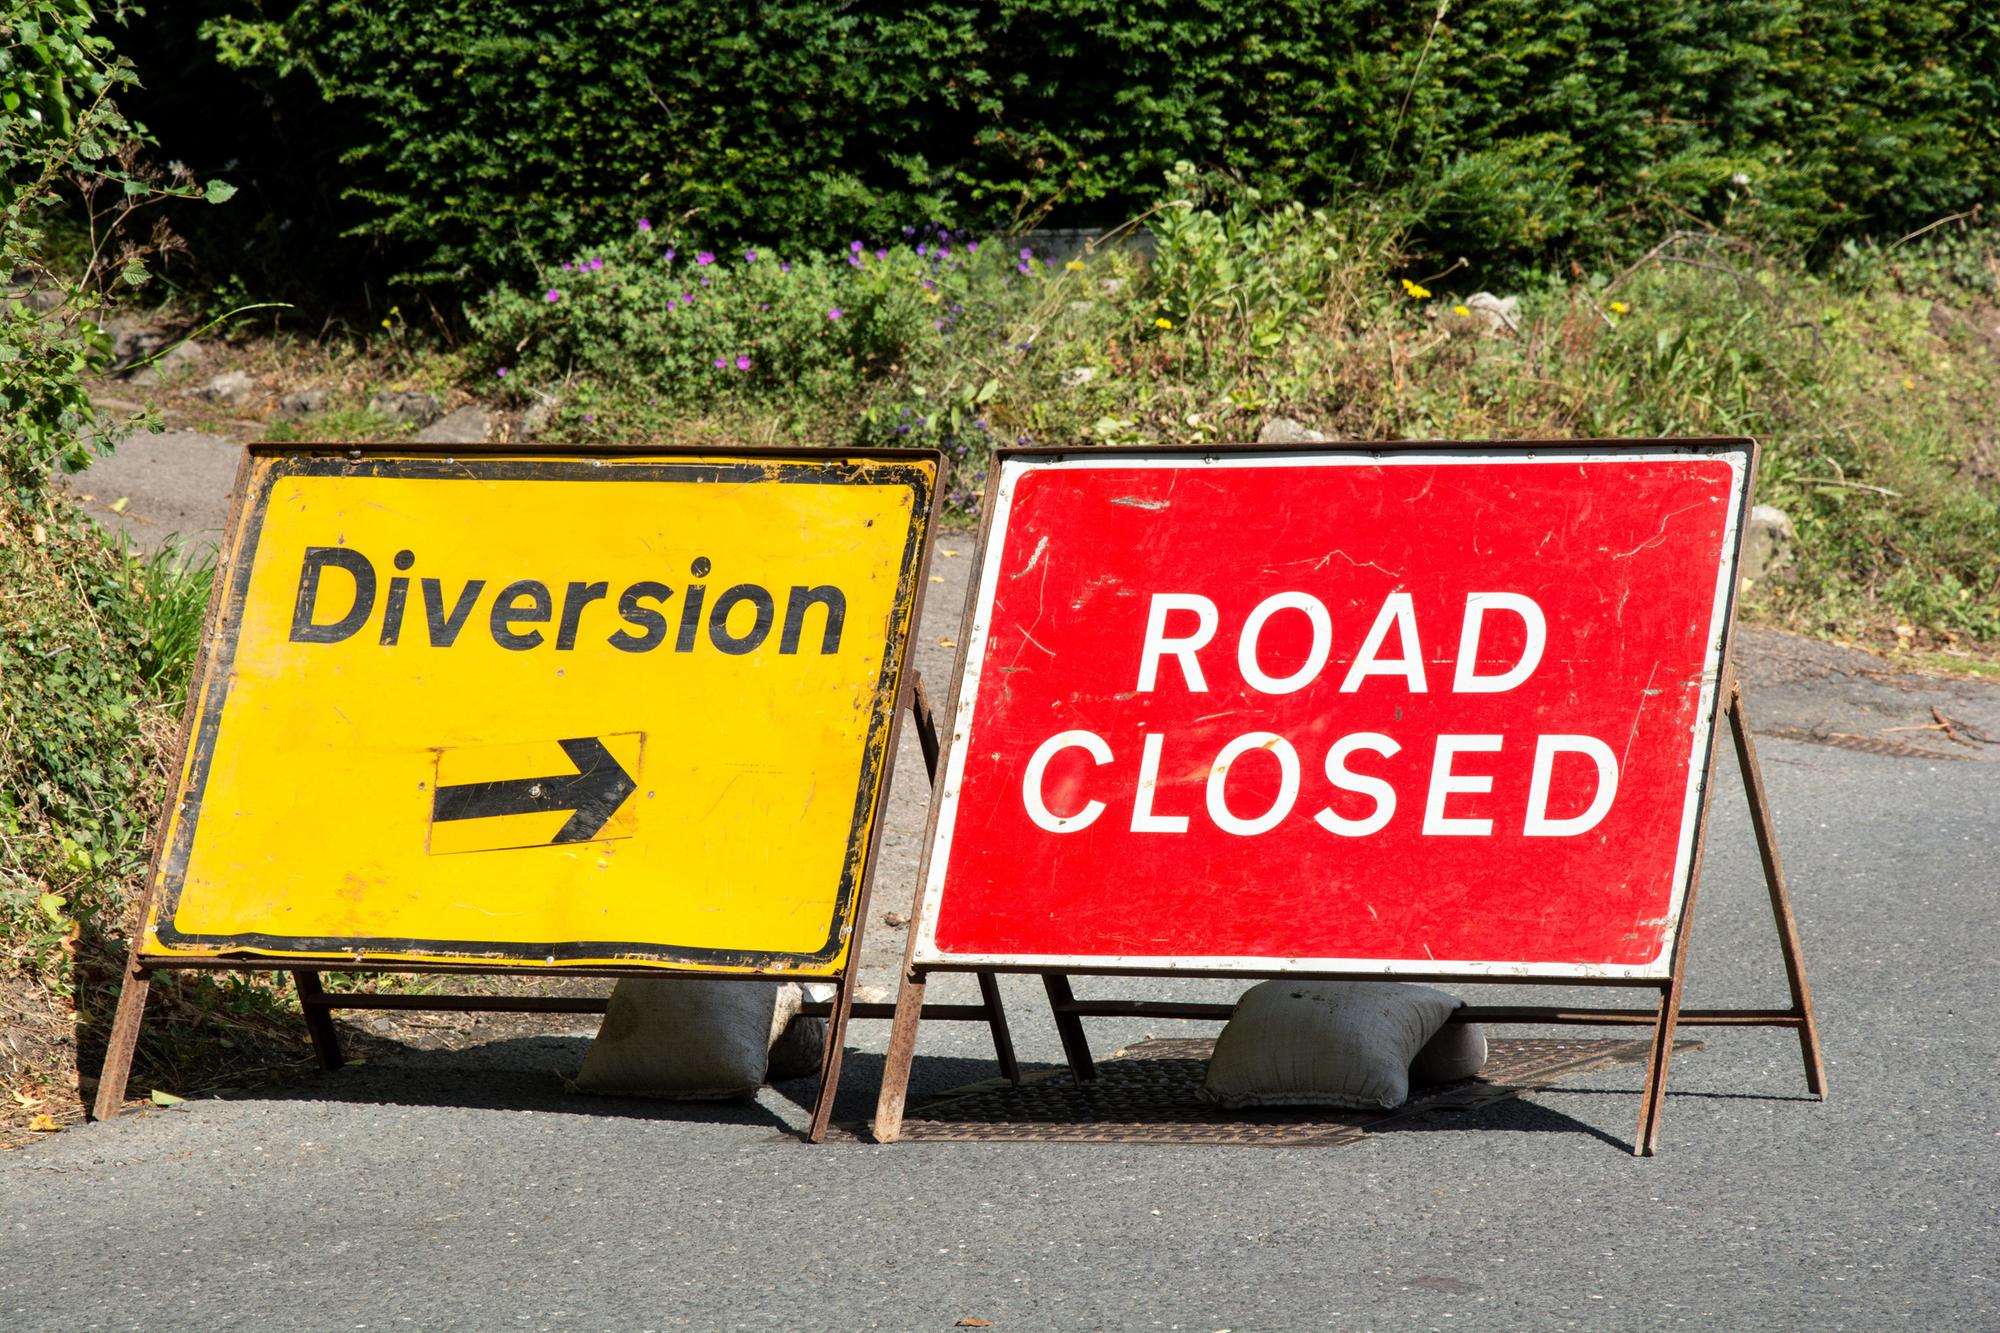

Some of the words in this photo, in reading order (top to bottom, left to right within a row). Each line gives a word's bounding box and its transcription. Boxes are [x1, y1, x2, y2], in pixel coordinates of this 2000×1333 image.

[290, 547, 847, 655] Diversion
[1137, 590, 1547, 694] ROAD
[1022, 730, 1619, 837] CLOSED
